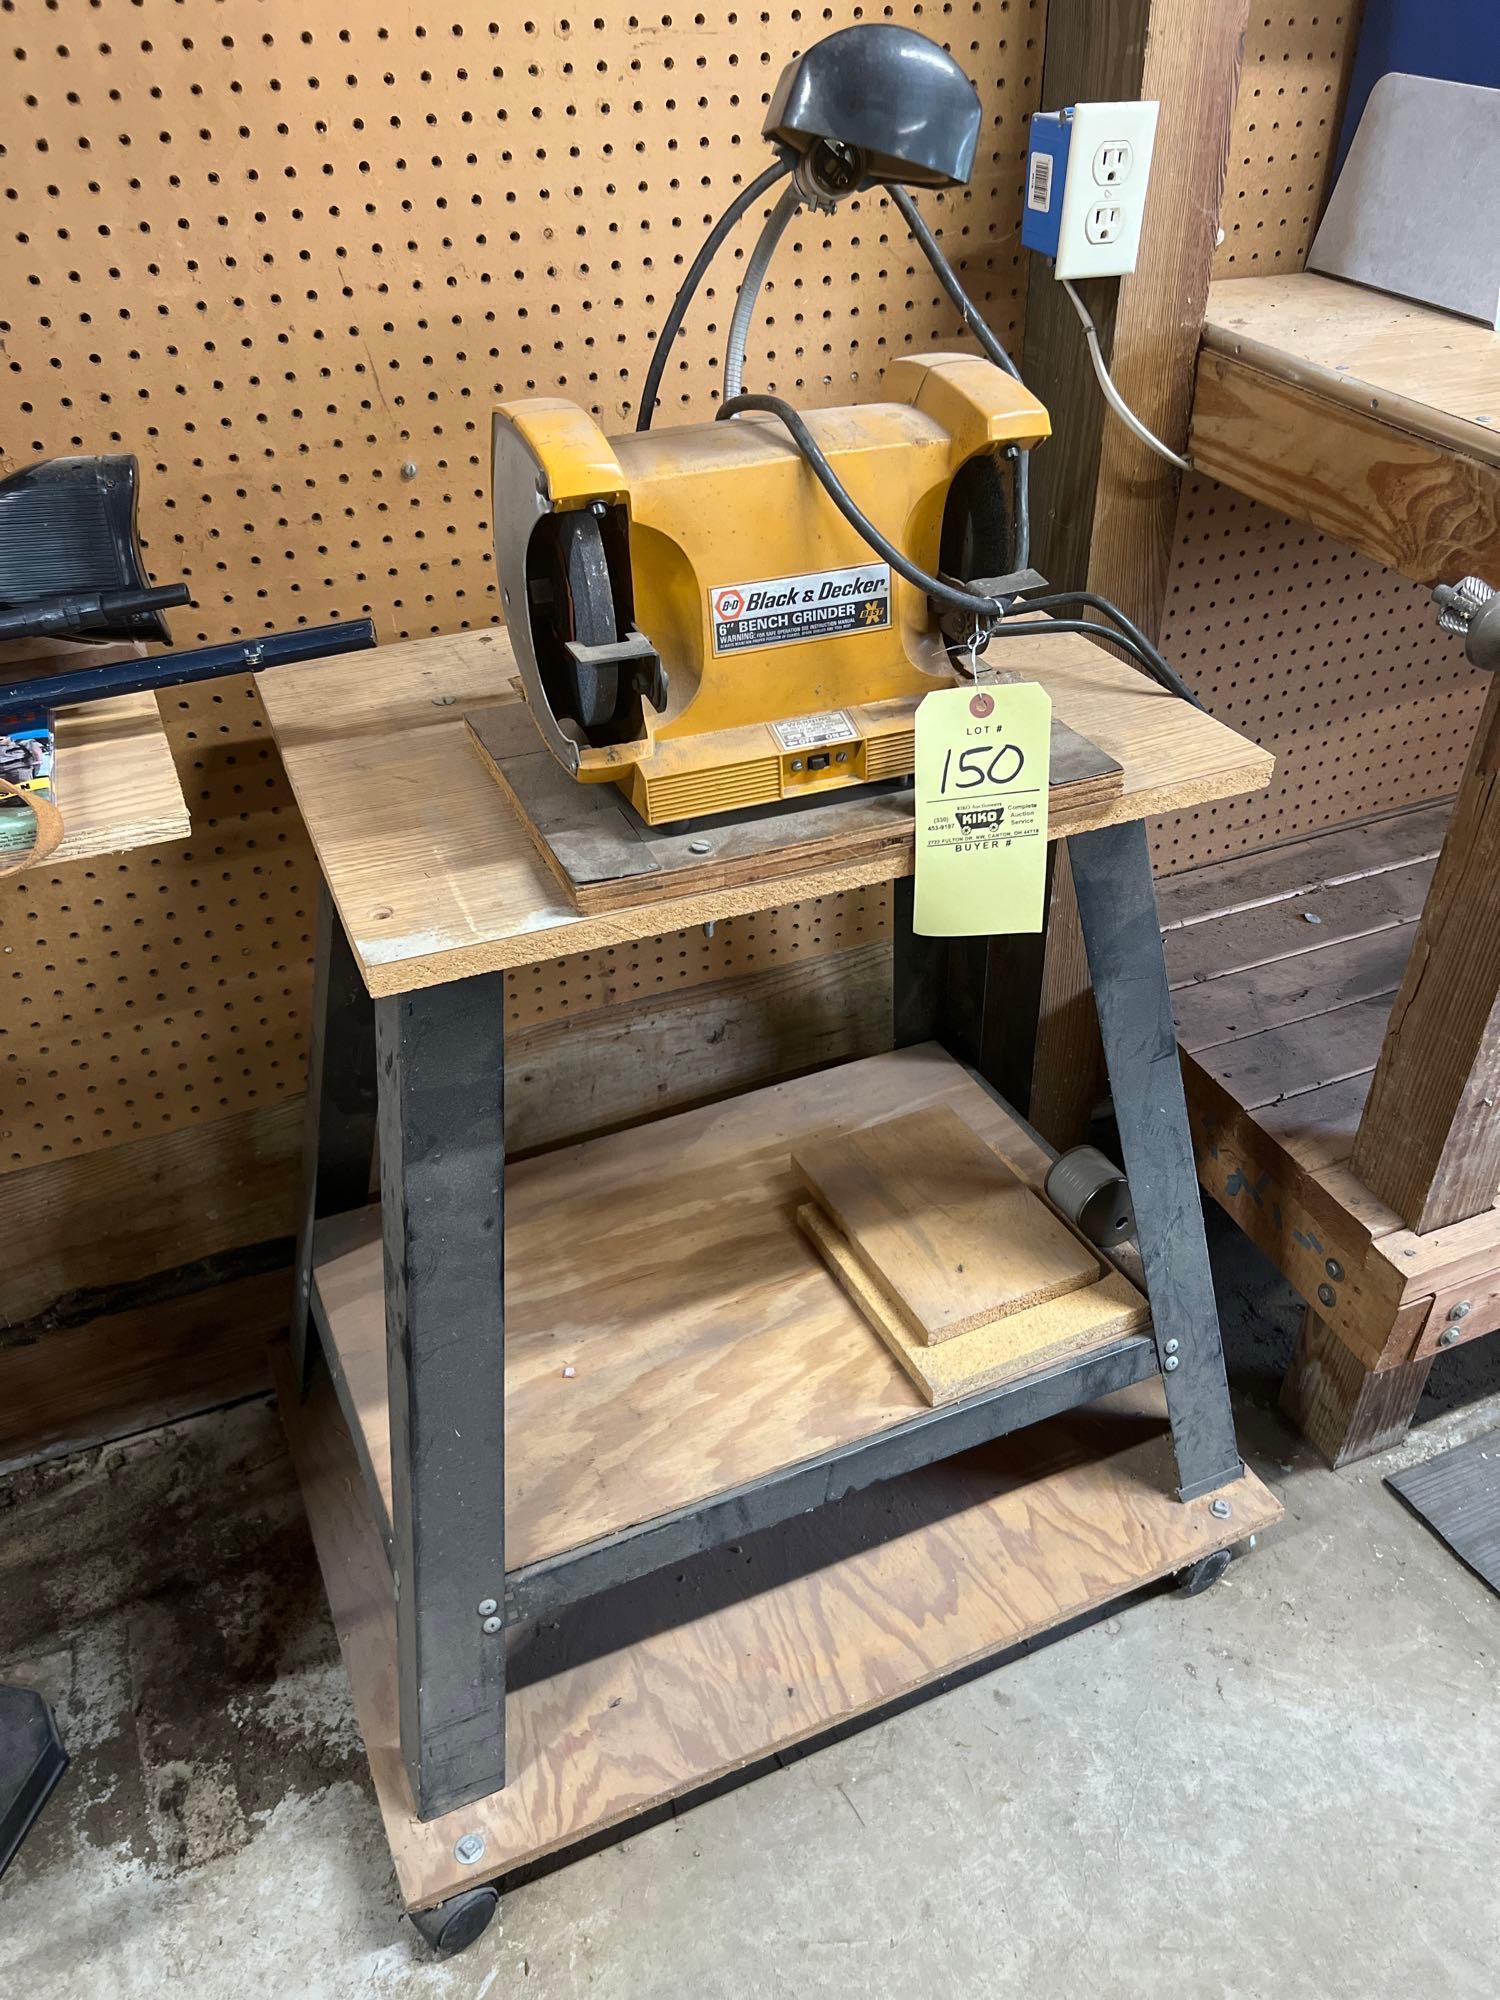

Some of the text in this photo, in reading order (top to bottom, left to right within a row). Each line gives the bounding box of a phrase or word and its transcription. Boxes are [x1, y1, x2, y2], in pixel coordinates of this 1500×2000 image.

[746, 577, 886, 612] Black & Decker
[738, 614, 789, 633] BENCH
[792, 604, 856, 625] GRINDER
[719, 631, 756, 644] WARNING:
[777, 625, 801, 635] OPERATION
[837, 617, 856, 626] MANUAL
[966, 724, 1003, 736] LOT #
[940, 743, 1025, 794] 150
[1007, 803, 1038, 811] Complete
[1010, 810, 1035, 818] Auction
[933, 816, 949, 824] (330)
[961, 811, 998, 825] KIKO
[1010, 818, 1034, 826] Service
[955, 839, 1012, 853] BUYER #
